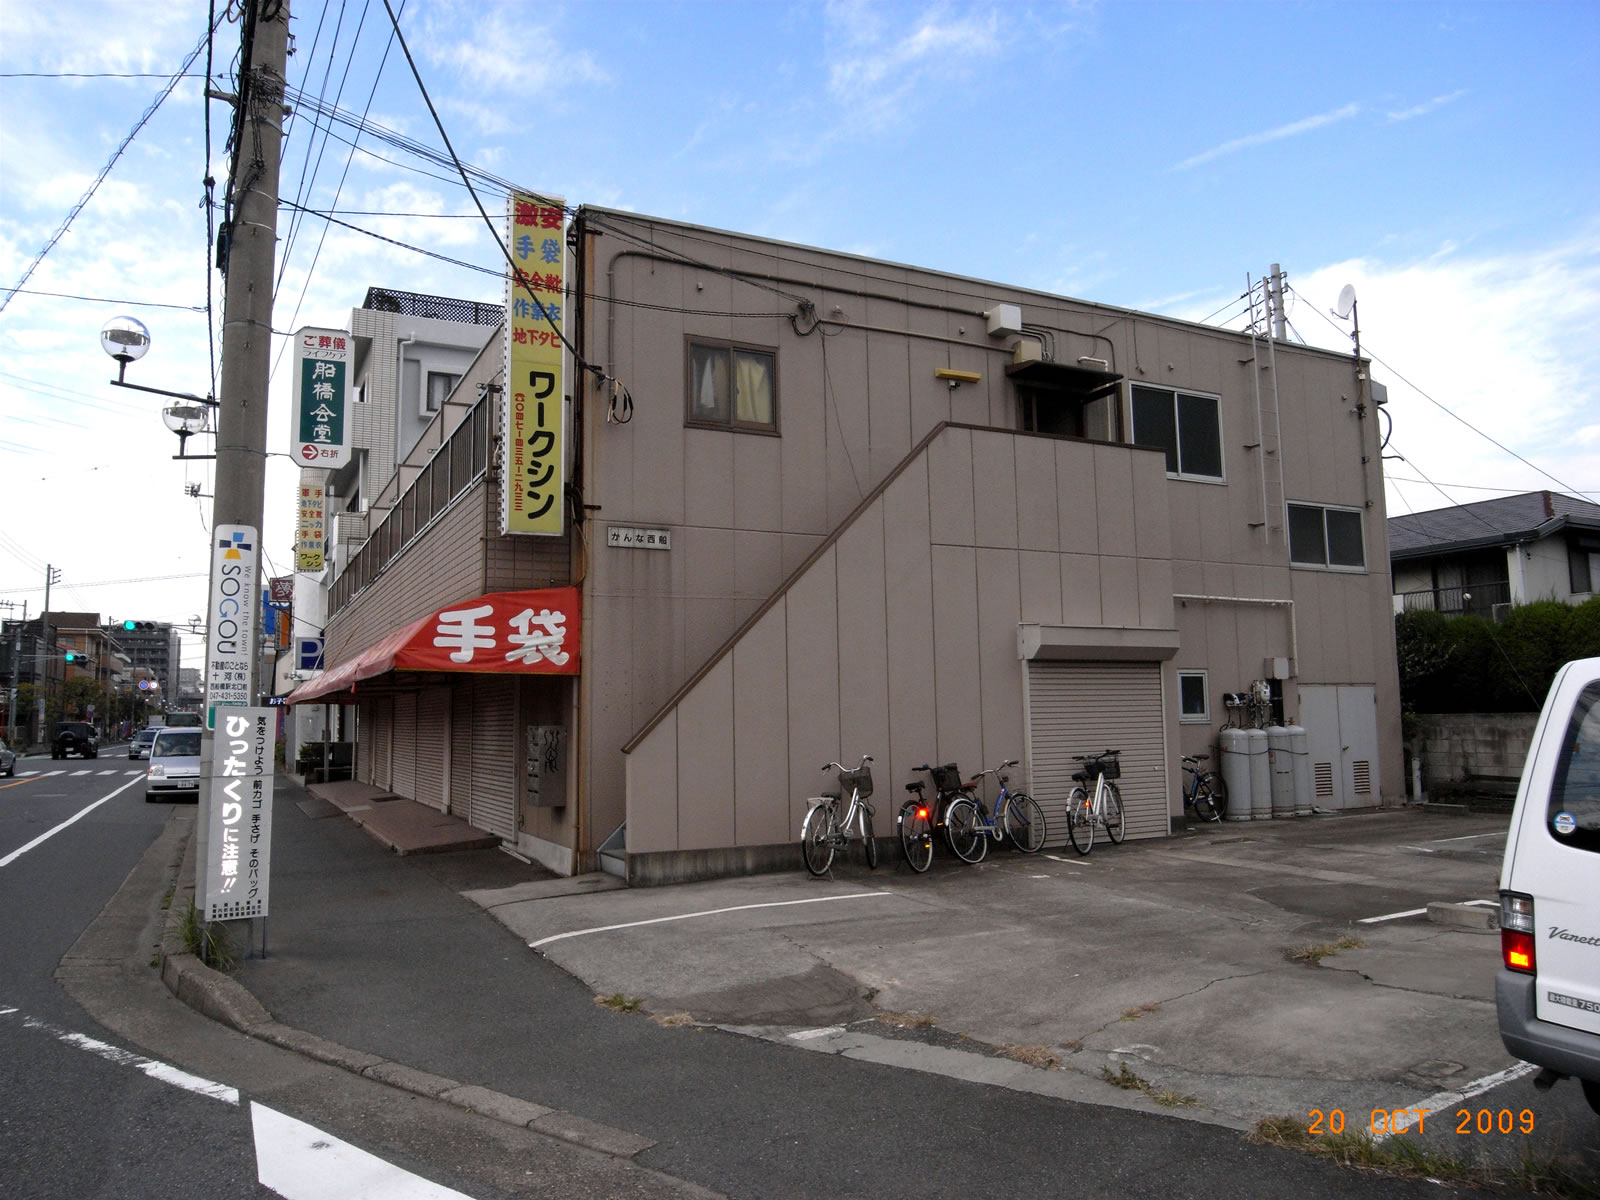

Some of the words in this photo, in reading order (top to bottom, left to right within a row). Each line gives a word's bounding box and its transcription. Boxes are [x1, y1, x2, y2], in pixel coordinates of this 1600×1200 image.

[515, 234, 561, 264] 手袋
[513, 298, 562, 322] 作業衣
[303, 335, 347, 351] ご葬儀
[310, 361, 337, 443] 船橋会堂
[320, 448, 339, 459] 右折
[527, 370, 556, 519] ワークシン
[611, 533, 668, 545] かんな西船
[243, 565, 252, 579] We
[242, 583, 251, 608] know
[216, 564, 242, 655] SOGOU
[241, 610, 250, 626] the
[433, 604, 570, 666] 手袋
[211, 661, 249, 671] 不動産のことなら
[209, 691, 248, 701] 047-431-5350
[254, 716, 266, 776] 気をつけよう
[251, 780, 263, 810] 前カゴ
[249, 813, 261, 845] 手さげ
[247, 848, 259, 900] そのバッグ
